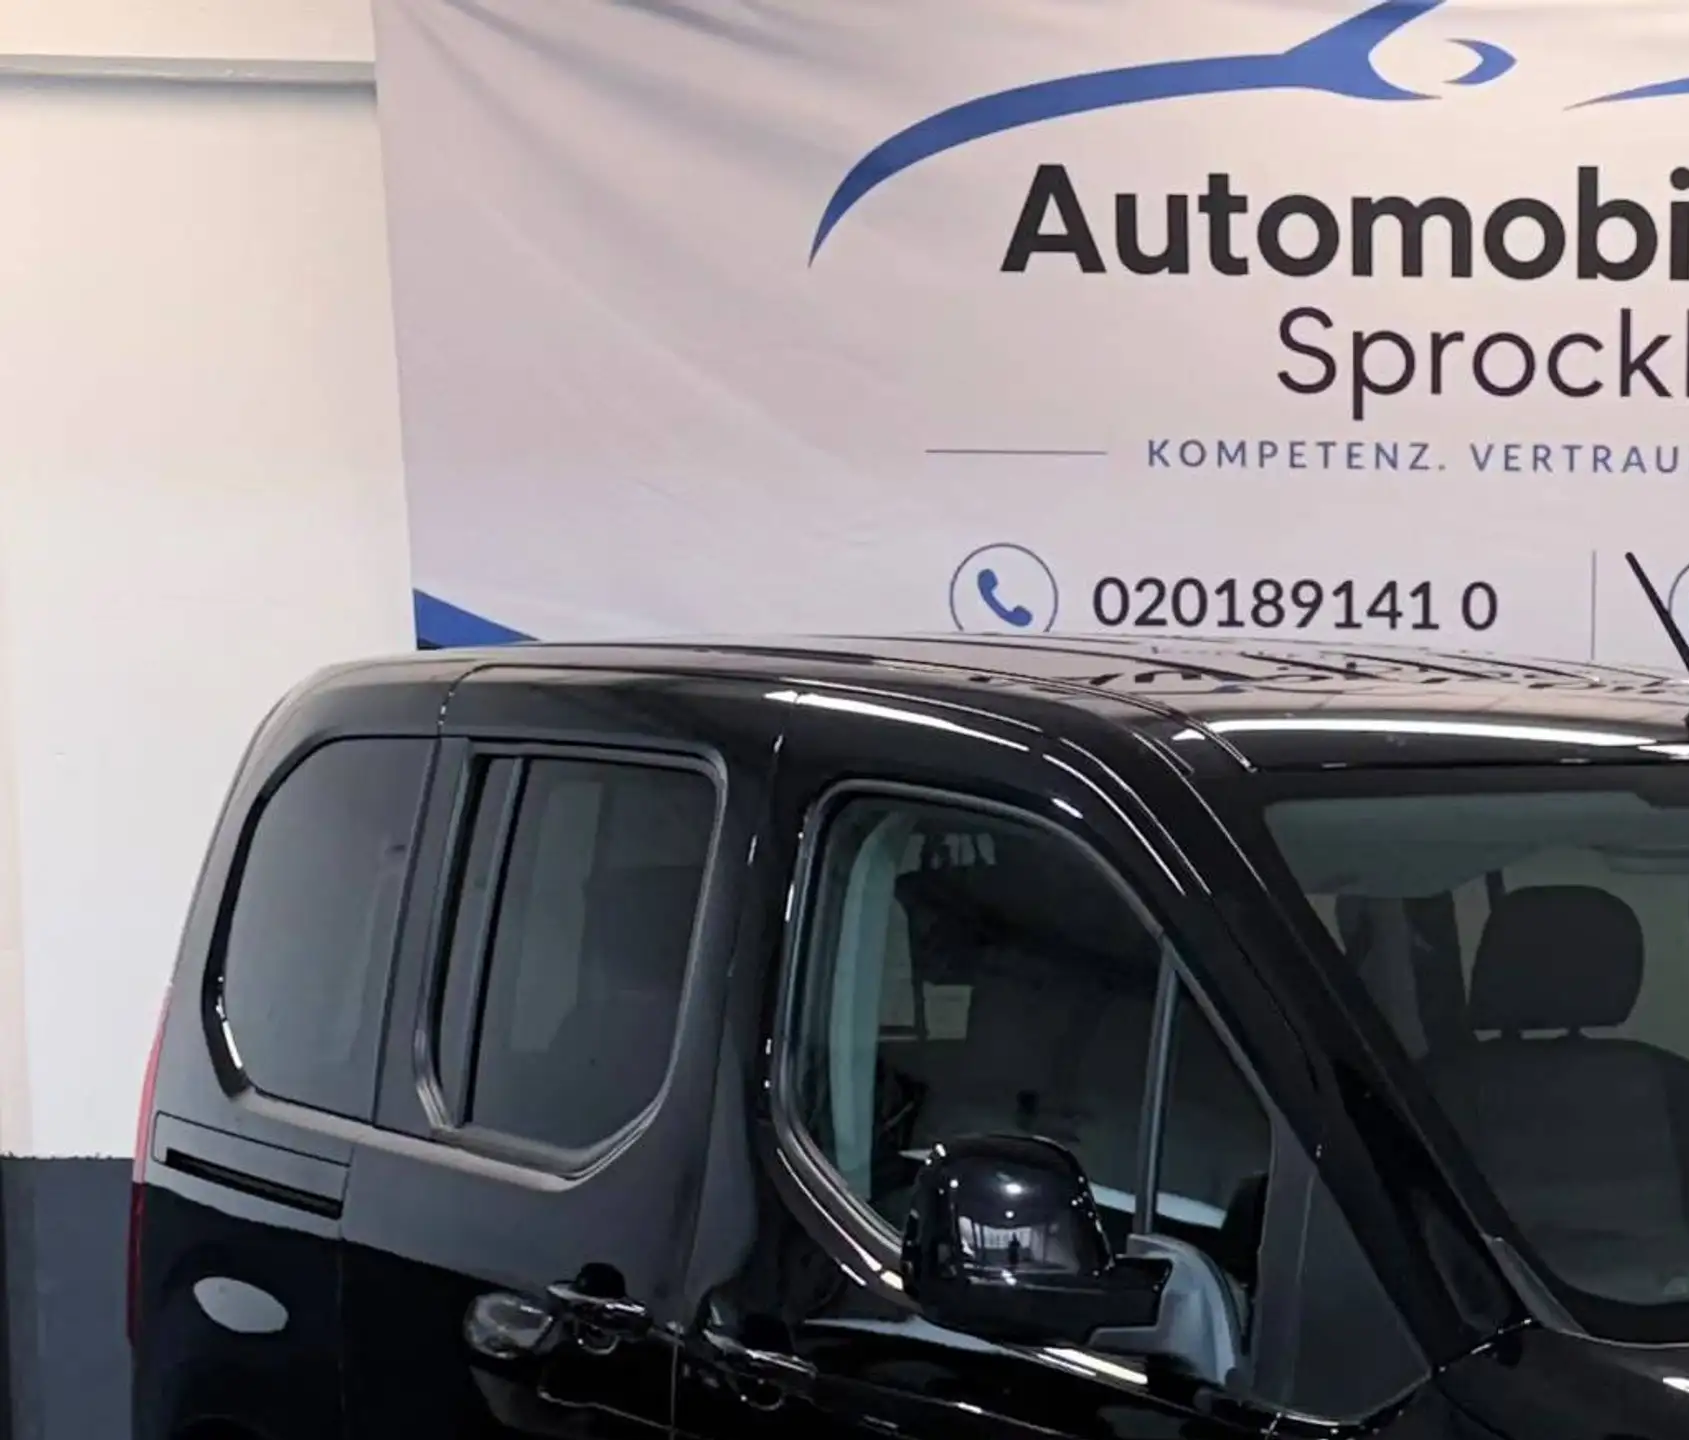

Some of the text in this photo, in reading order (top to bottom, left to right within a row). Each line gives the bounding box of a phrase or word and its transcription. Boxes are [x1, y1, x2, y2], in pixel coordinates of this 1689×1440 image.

[1148, 440, 1447, 471] KOMPETENZ.
[1092, 577, 1500, 631] 020189141 0
